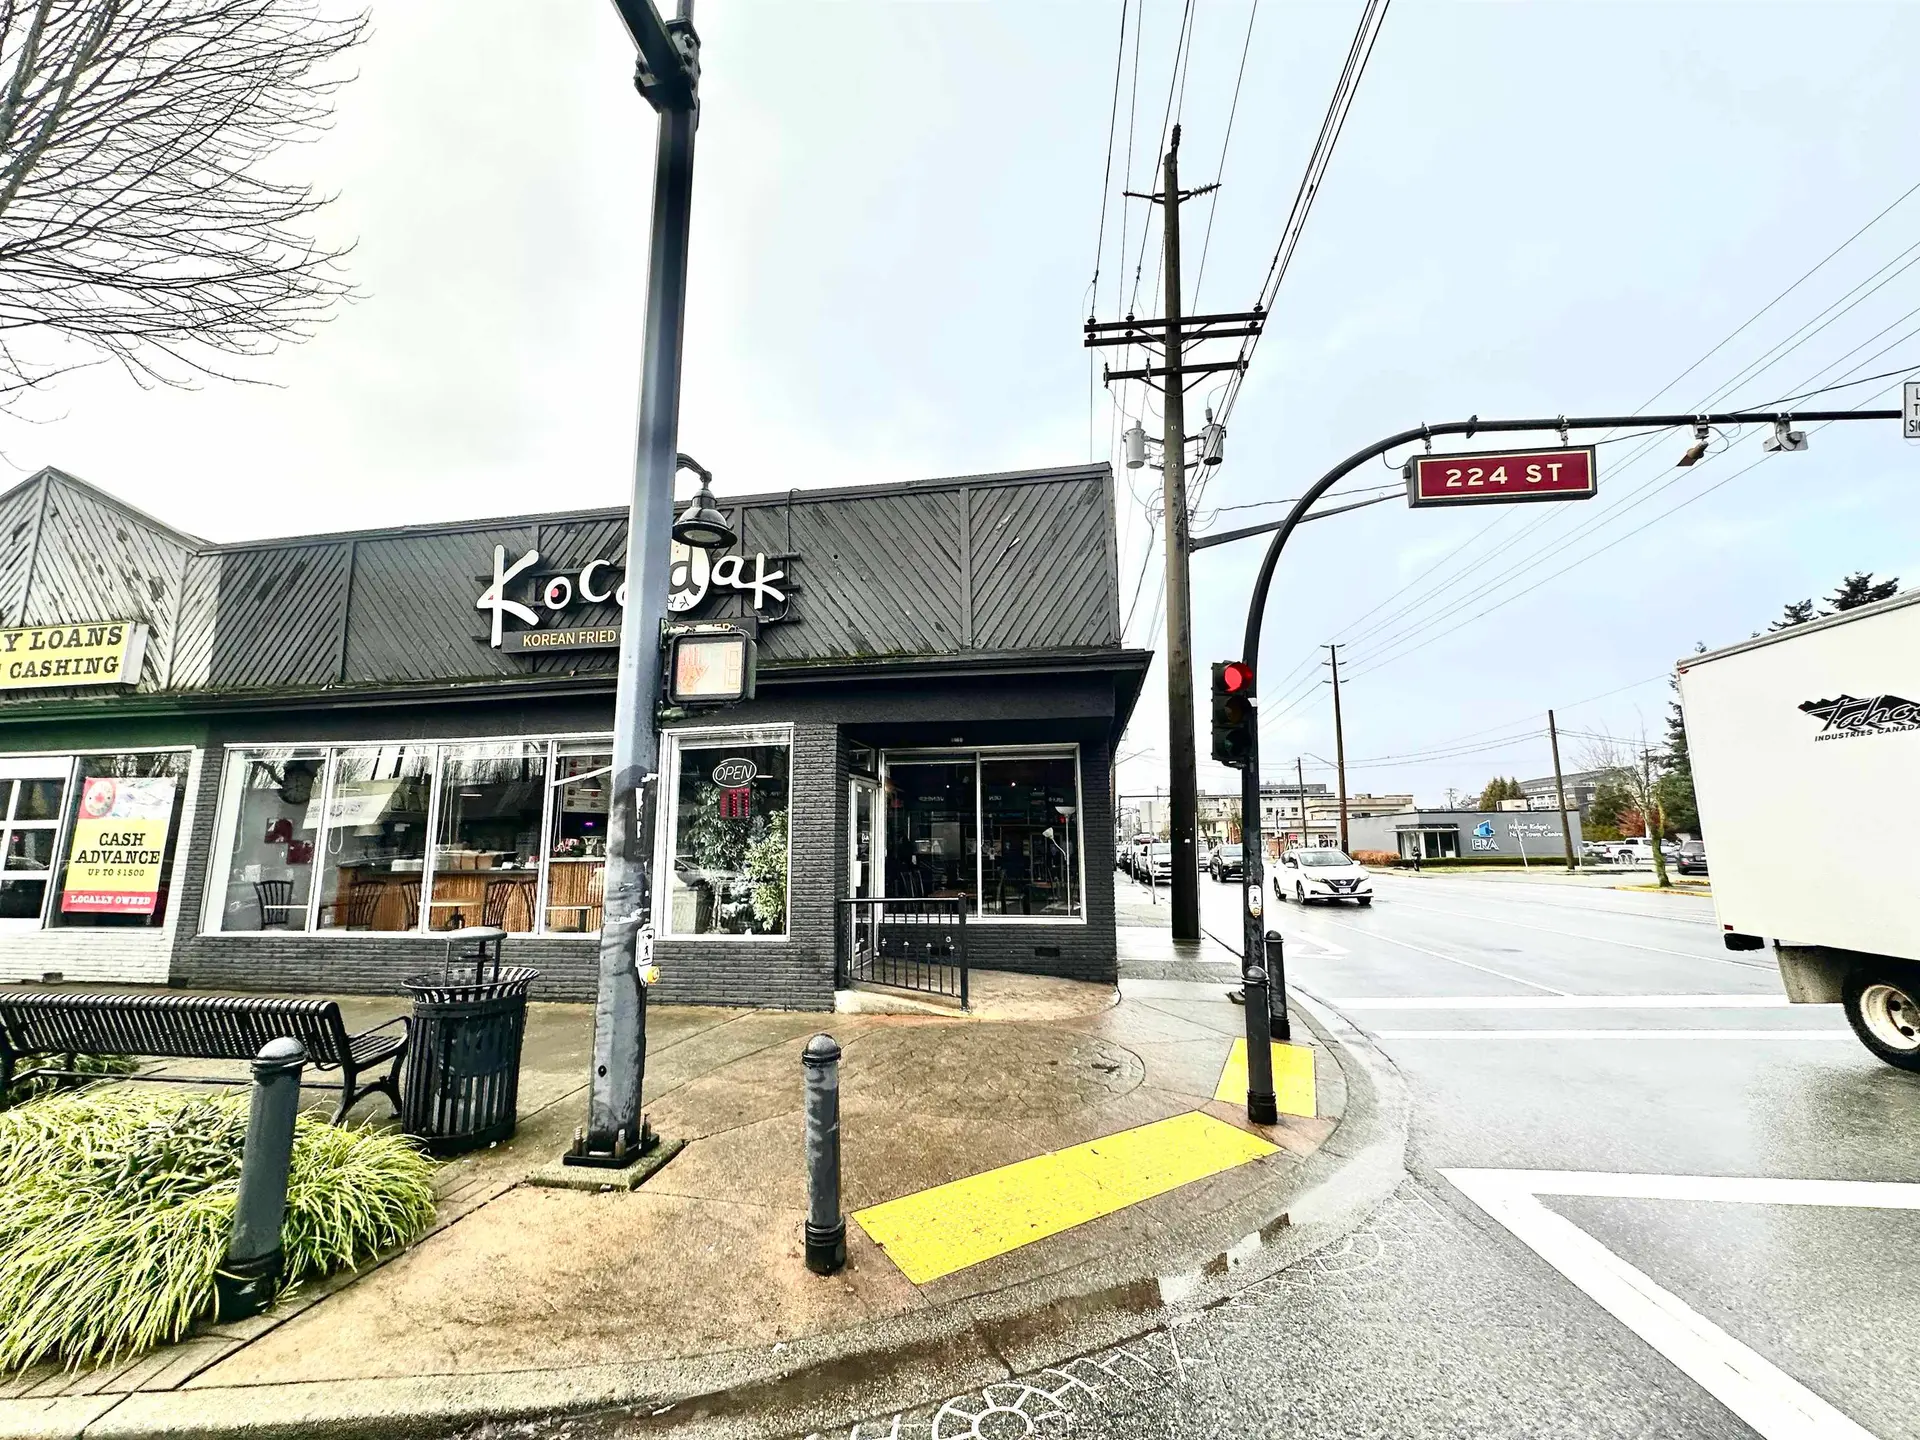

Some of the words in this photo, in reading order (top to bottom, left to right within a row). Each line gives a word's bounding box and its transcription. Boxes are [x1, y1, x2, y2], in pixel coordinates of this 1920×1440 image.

[1445, 466, 1508, 487] 224
[1526, 463, 1563, 483] ST
[29, 625, 123, 651] LOANS
[523, 632, 576, 647] KOREAN
[578, 629, 616, 644] FRIED
[10, 655, 119, 679] CASHING
[1814, 729, 1873, 742] INDUSTRIES
[715, 764, 753, 781] OPEN
[99, 832, 146, 847] CASH
[1471, 838, 1500, 851] ERA
[75, 850, 161, 865] ADVANCE
[88, 868, 100, 876] UP
[103, 868, 114, 876] TO
[117, 868, 145, 877] $1500
[70, 895, 114, 905] LOCALLY
[115, 896, 151, 906] OWNED
